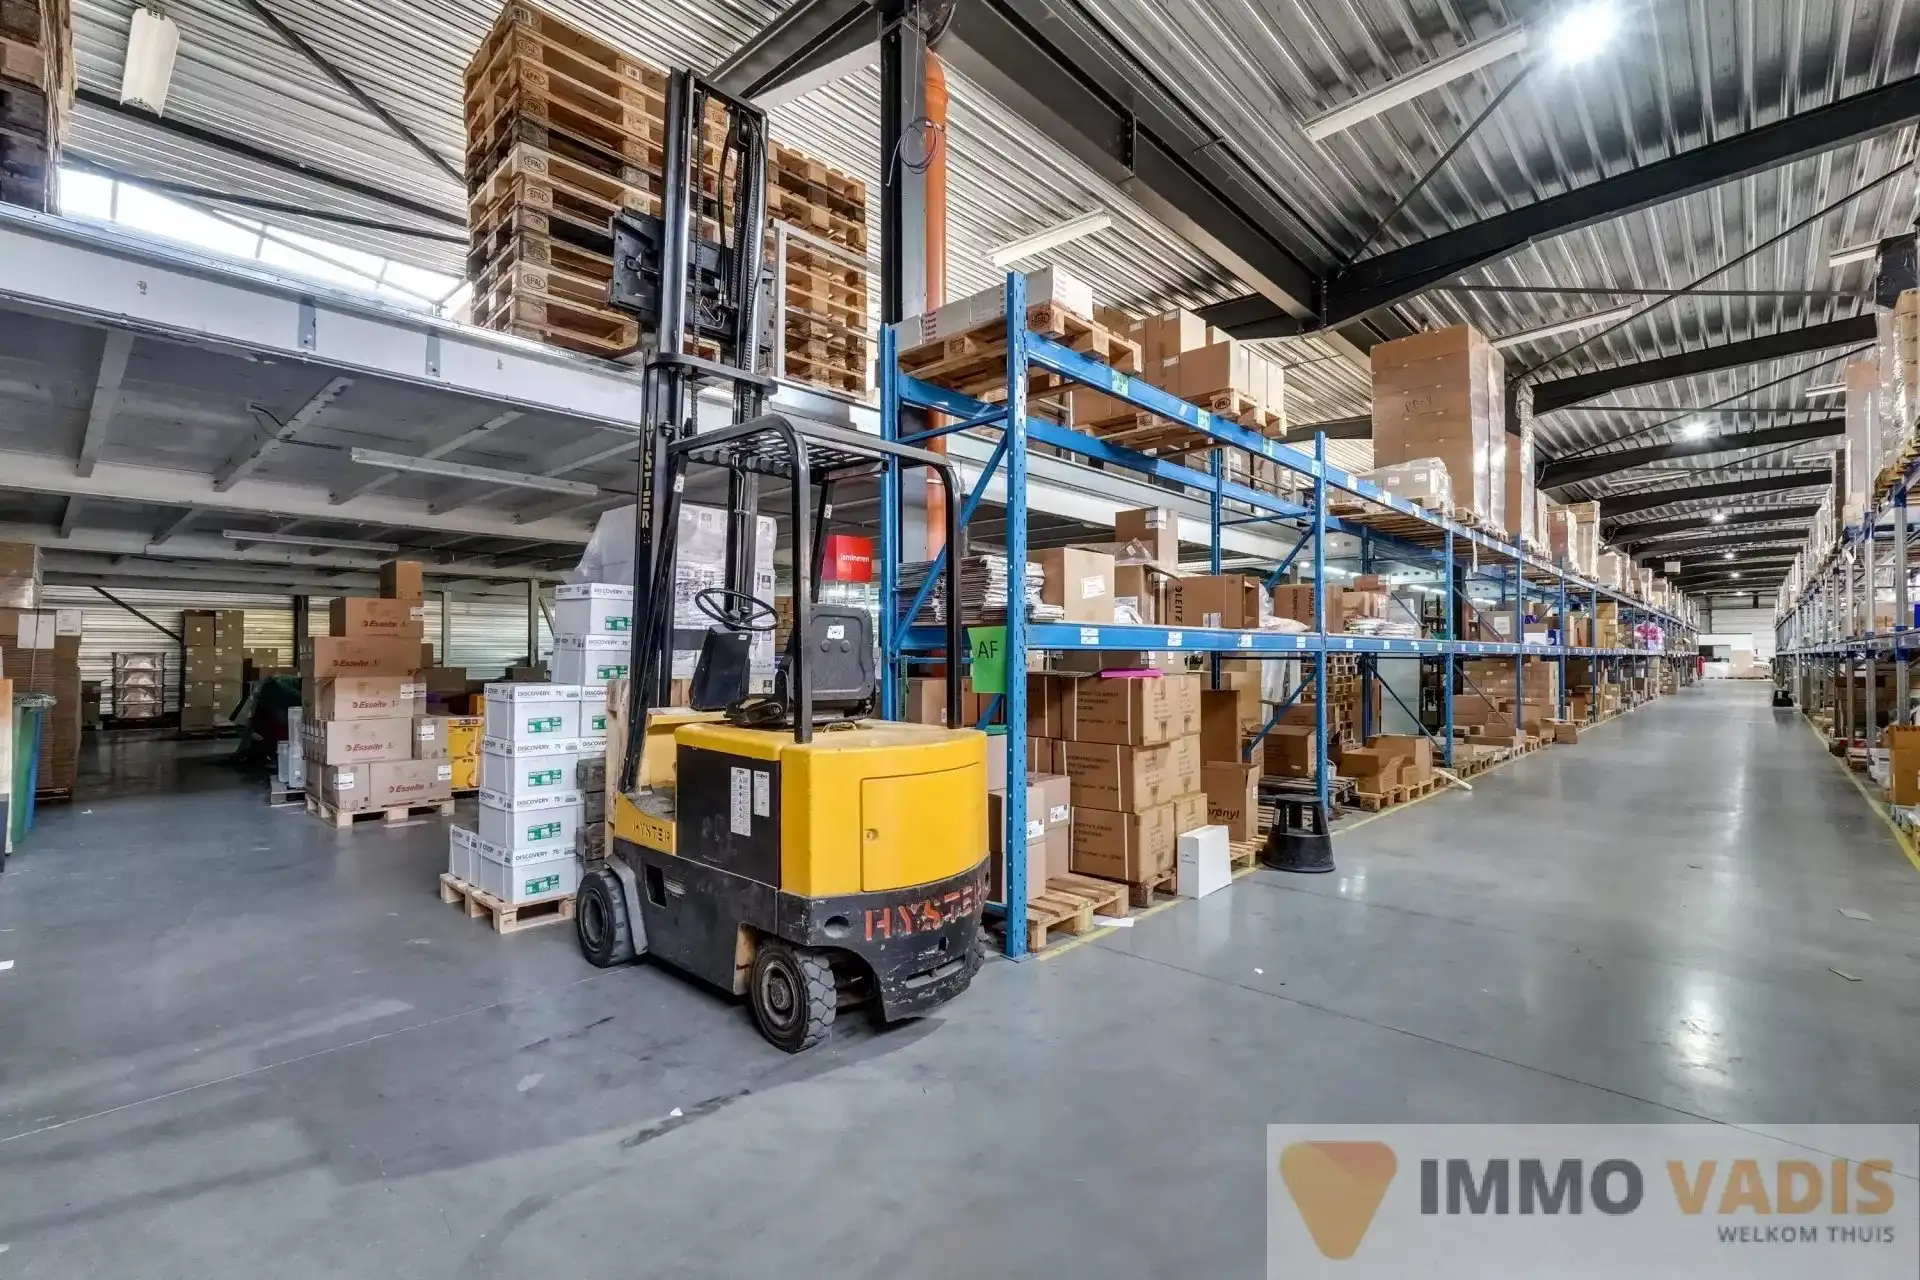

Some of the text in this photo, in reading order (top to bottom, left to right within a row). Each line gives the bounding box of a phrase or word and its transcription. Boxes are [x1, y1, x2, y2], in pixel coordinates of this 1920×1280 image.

[641, 412, 654, 528] HYSTER
[840, 553, 869, 562] lamineren
[978, 640, 998, 658] AF
[517, 744, 550, 752] DISCOVERY
[517, 798, 549, 806] DISCOVERY
[633, 820, 671, 844] HYSTER
[516, 851, 548, 860] DISCOVERY
